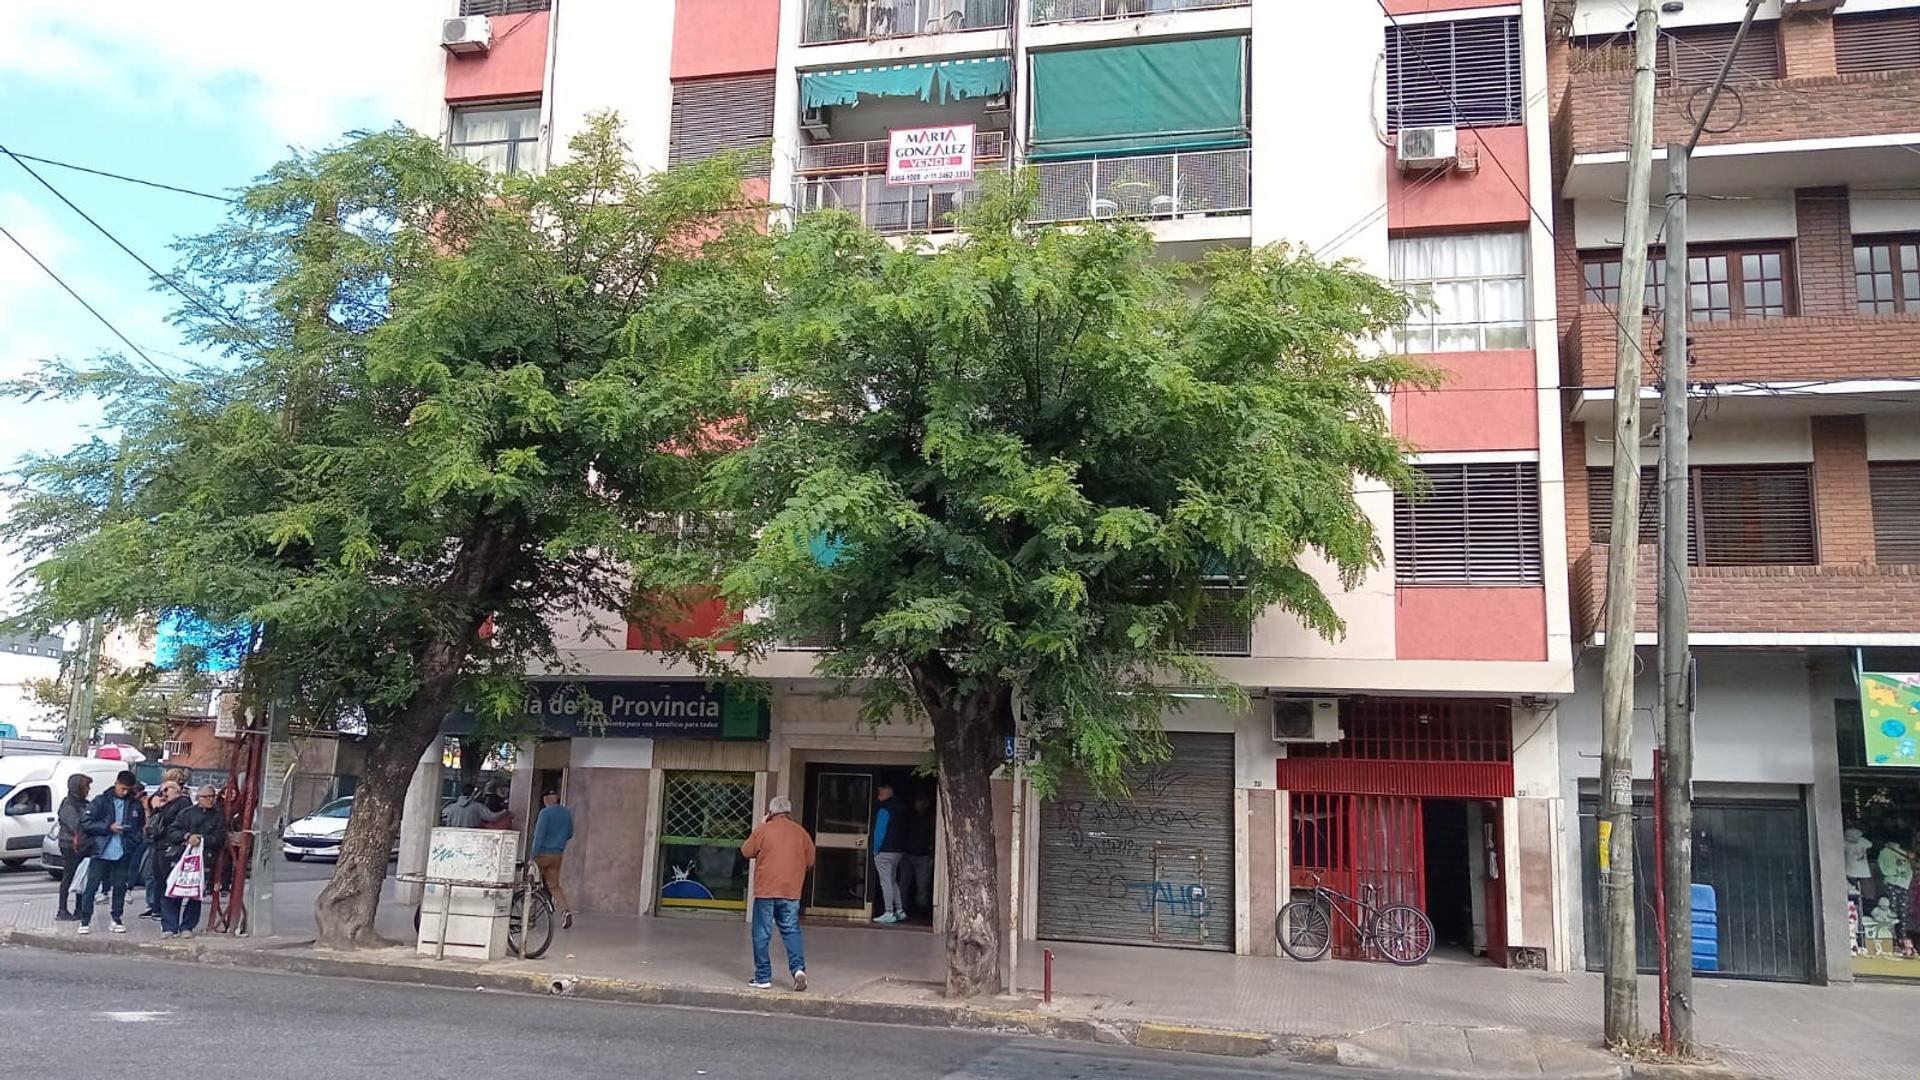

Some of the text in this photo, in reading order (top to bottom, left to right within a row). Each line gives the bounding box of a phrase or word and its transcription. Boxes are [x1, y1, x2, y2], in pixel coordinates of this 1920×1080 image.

[906, 129, 957, 144] MARTA
[910, 156, 952, 167] VENDE
[549, 694, 577, 715] de
[611, 694, 720, 717] Provincia
